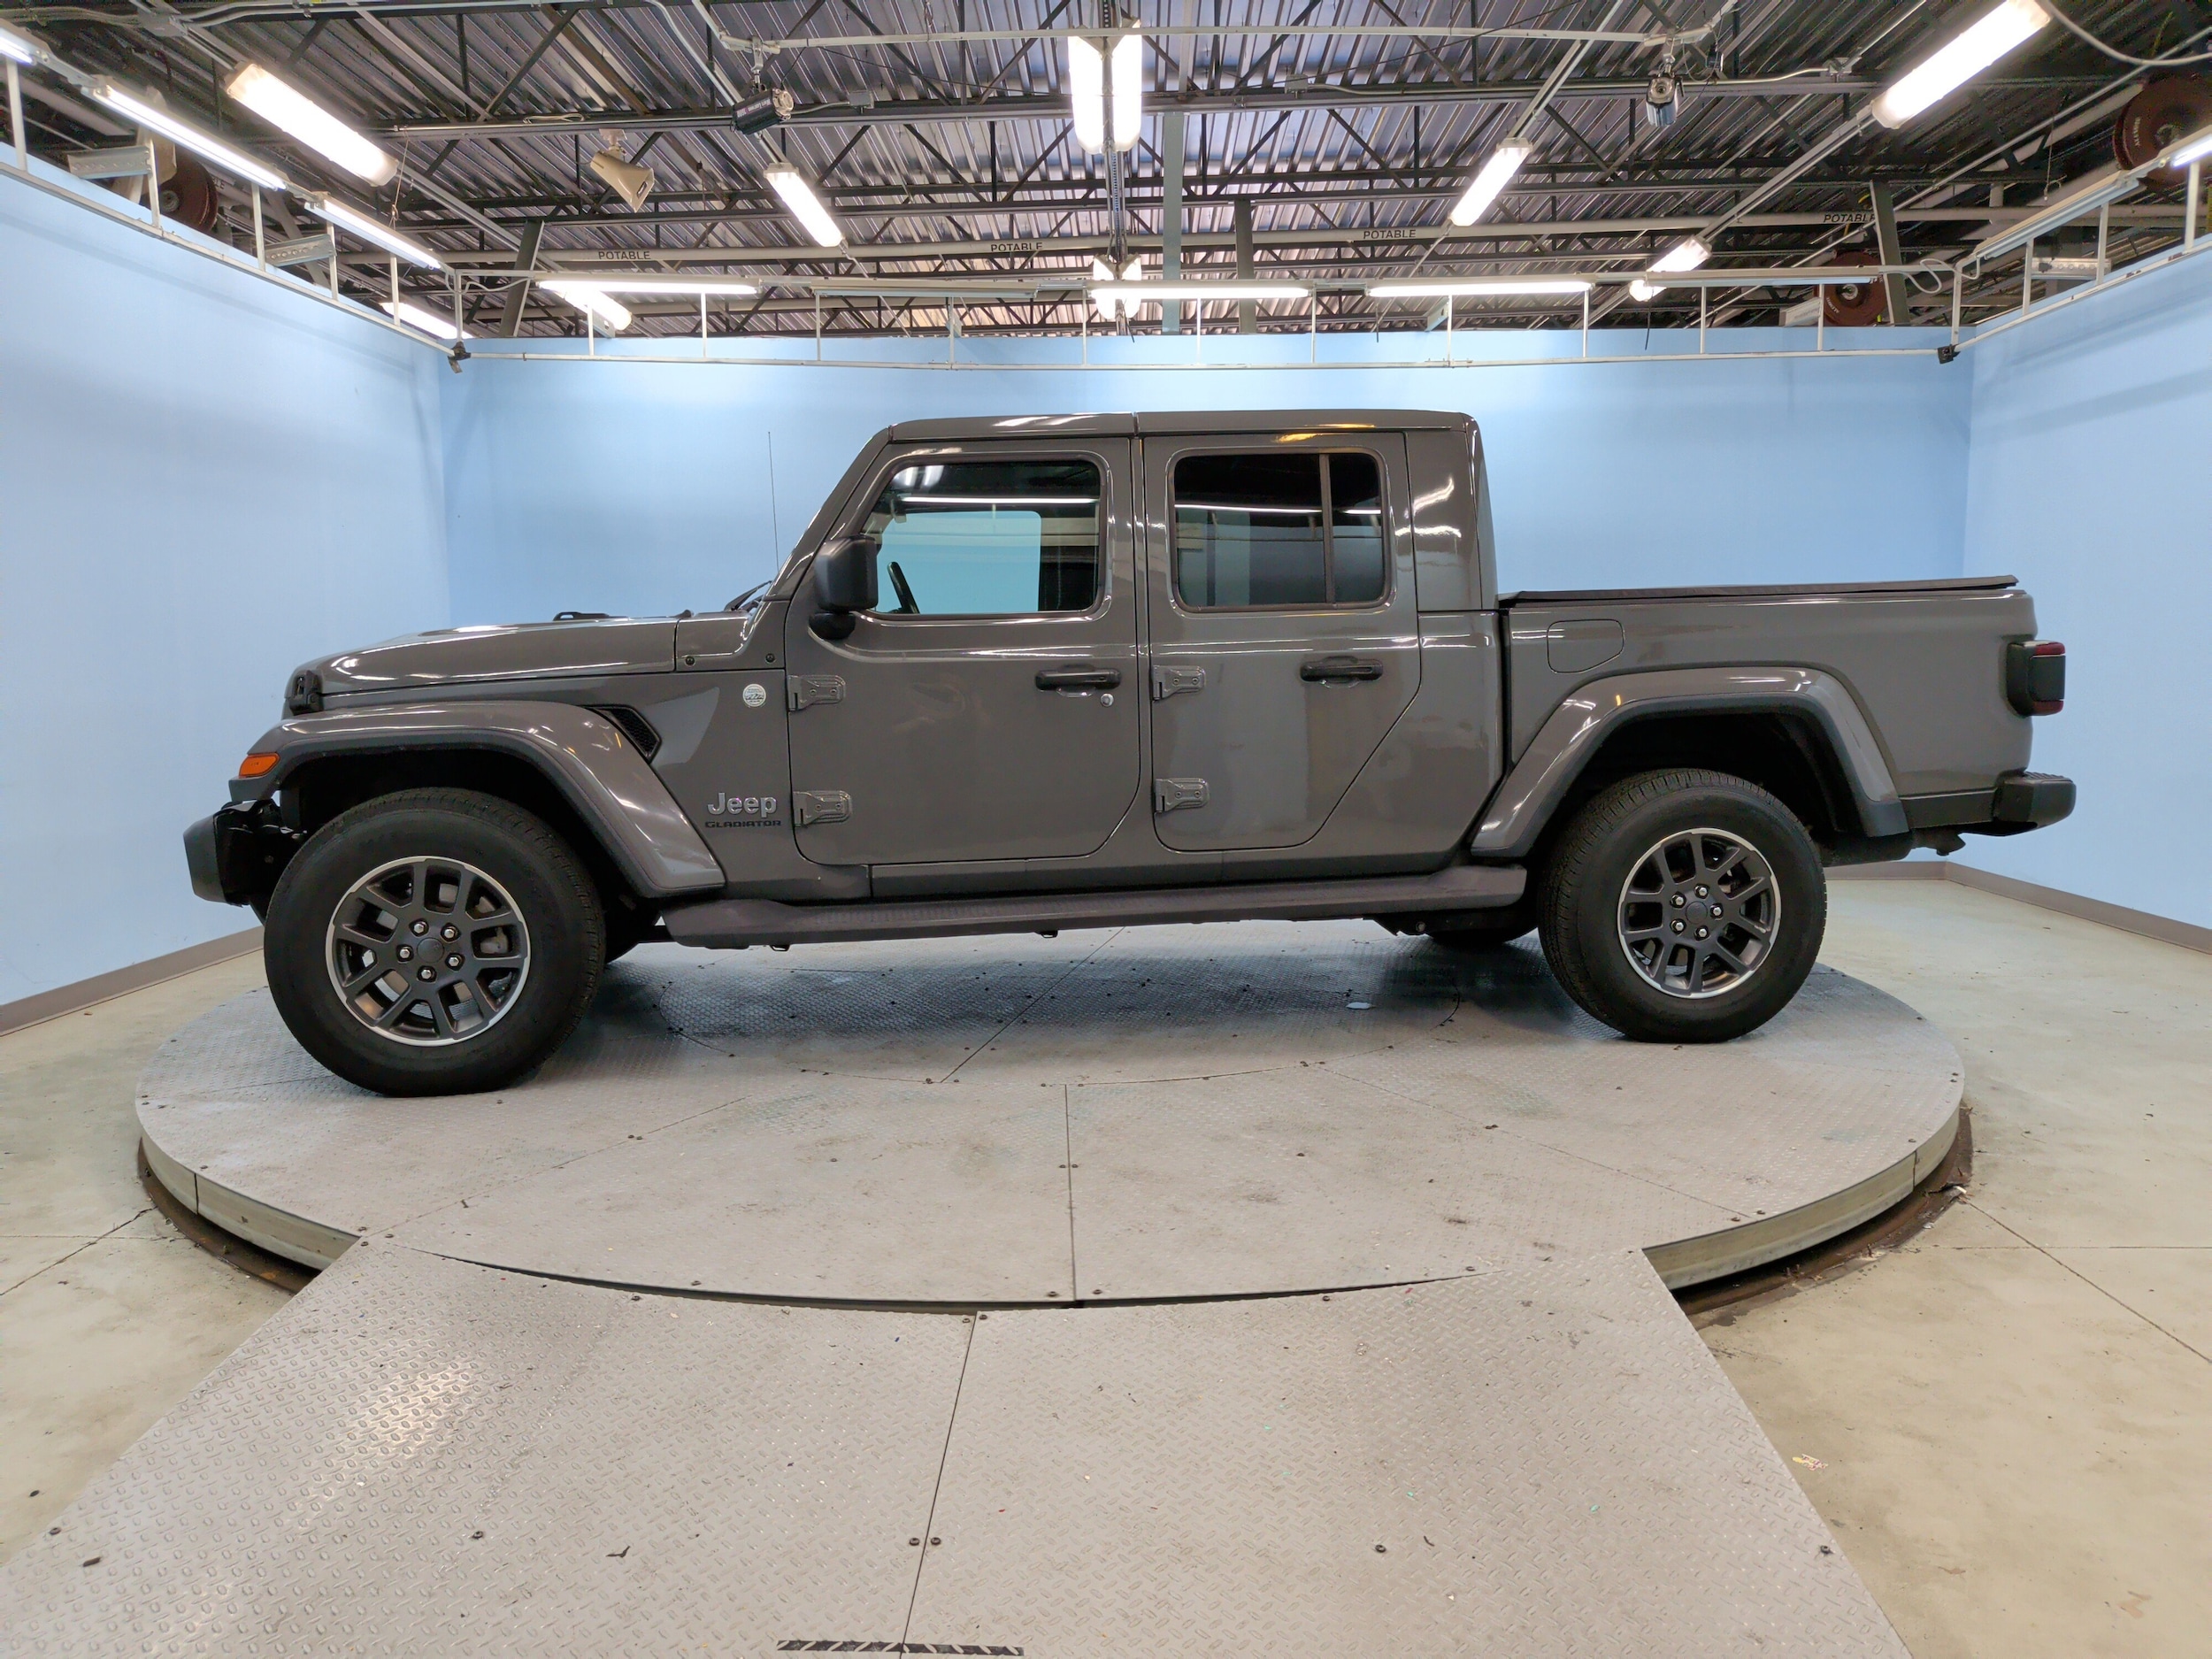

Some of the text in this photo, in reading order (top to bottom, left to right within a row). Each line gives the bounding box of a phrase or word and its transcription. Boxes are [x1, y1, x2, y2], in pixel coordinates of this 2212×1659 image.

[1363, 229, 1417, 240] POTABLE
[990, 242, 1043, 252] POTABLE
[598, 250, 651, 260] POTABLE
[707, 792, 777, 818] Jeep
